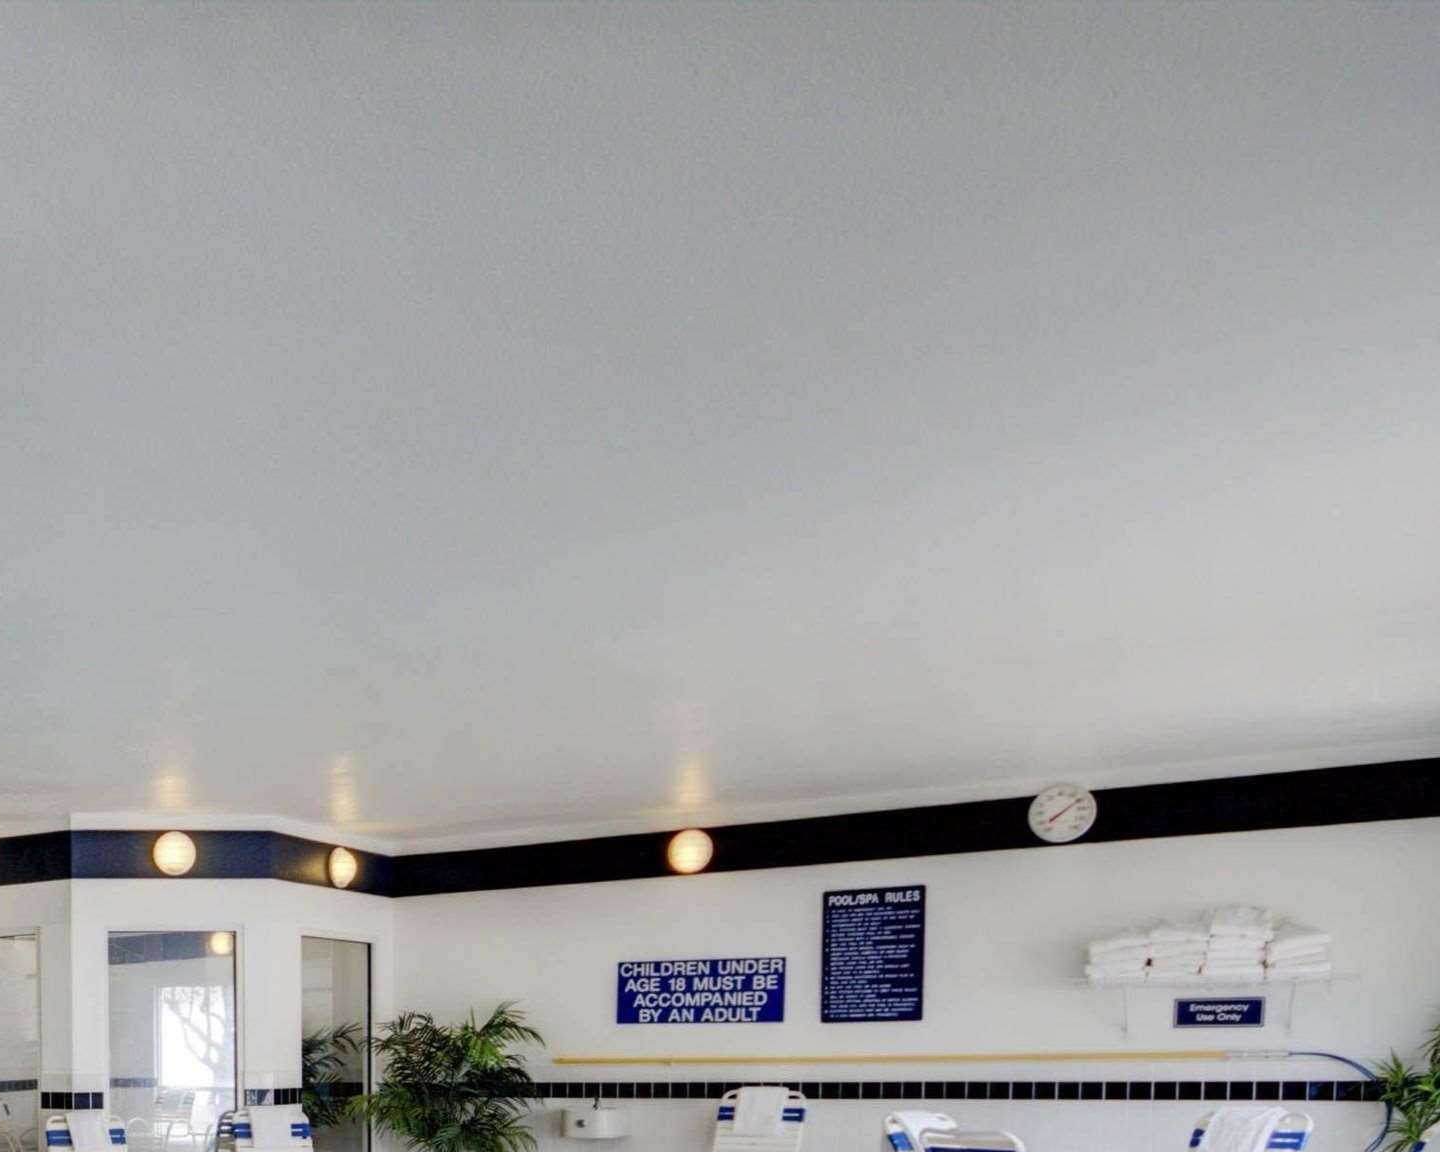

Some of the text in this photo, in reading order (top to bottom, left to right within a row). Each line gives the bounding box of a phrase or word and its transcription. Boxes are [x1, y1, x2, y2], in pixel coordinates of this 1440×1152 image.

[828, 890, 920, 907] POOL/SPA RULES
[620, 959, 783, 977] CHILDREN UNDER
[625, 975, 778, 992] AGE 18 MUST BE
[633, 991, 768, 1007] ACCOMPANIED
[639, 1008, 761, 1023] BY AN ADULT
[1189, 1003, 1249, 1013] Emergency
[1196, 1013, 1242, 1022] Use Only
